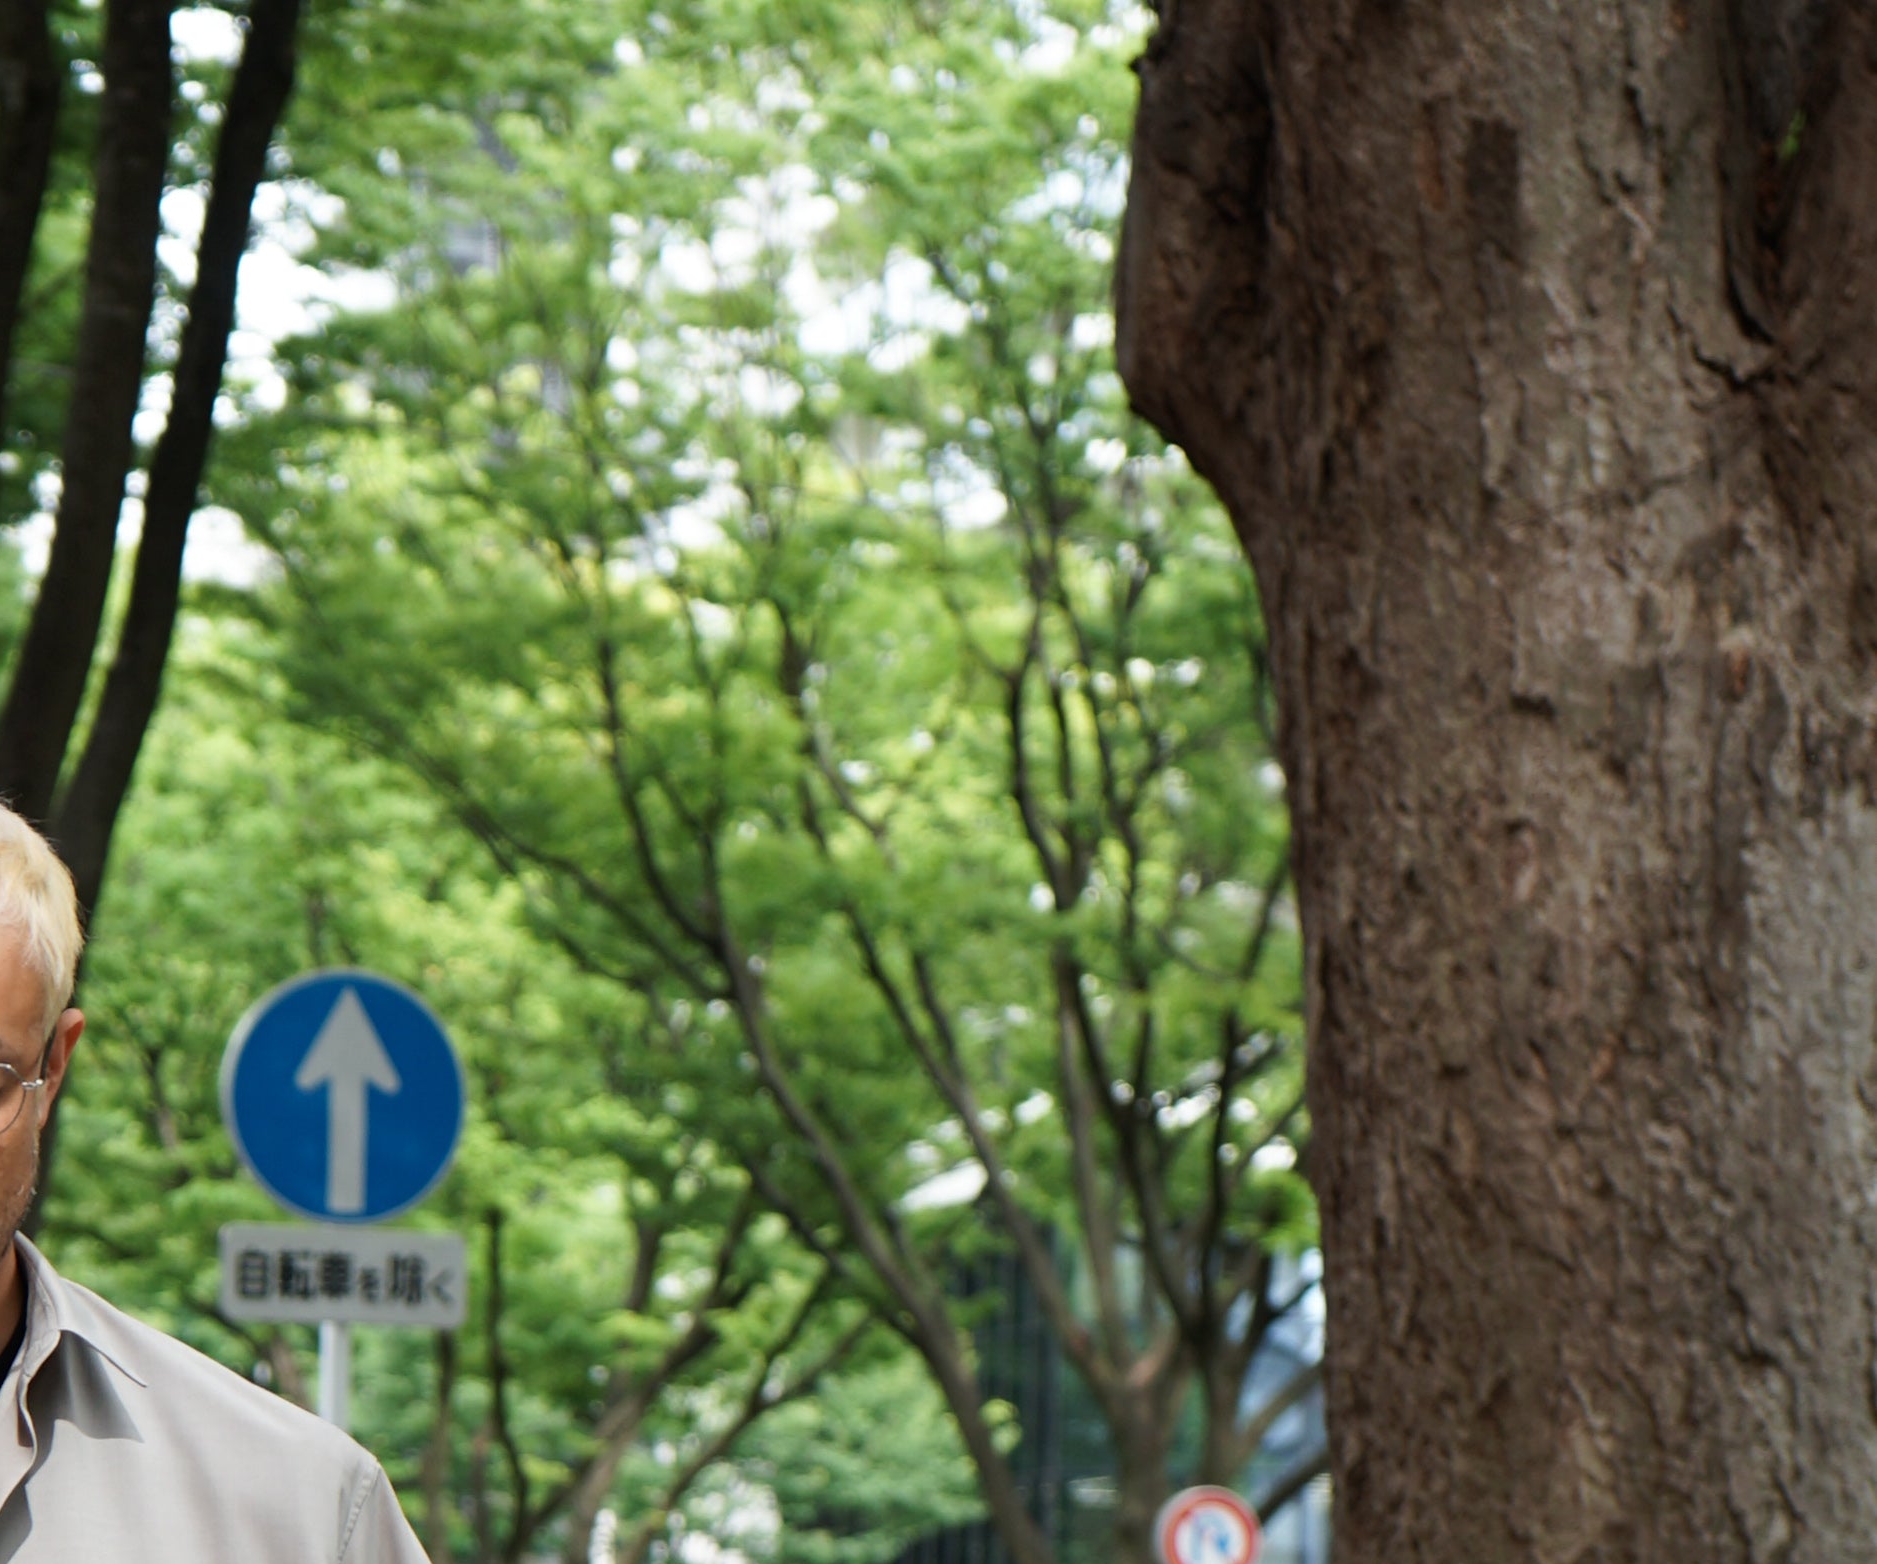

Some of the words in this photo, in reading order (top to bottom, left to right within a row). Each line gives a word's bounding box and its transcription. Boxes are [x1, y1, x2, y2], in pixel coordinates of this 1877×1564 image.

[236, 1249, 455, 1306] 自転車を除く
